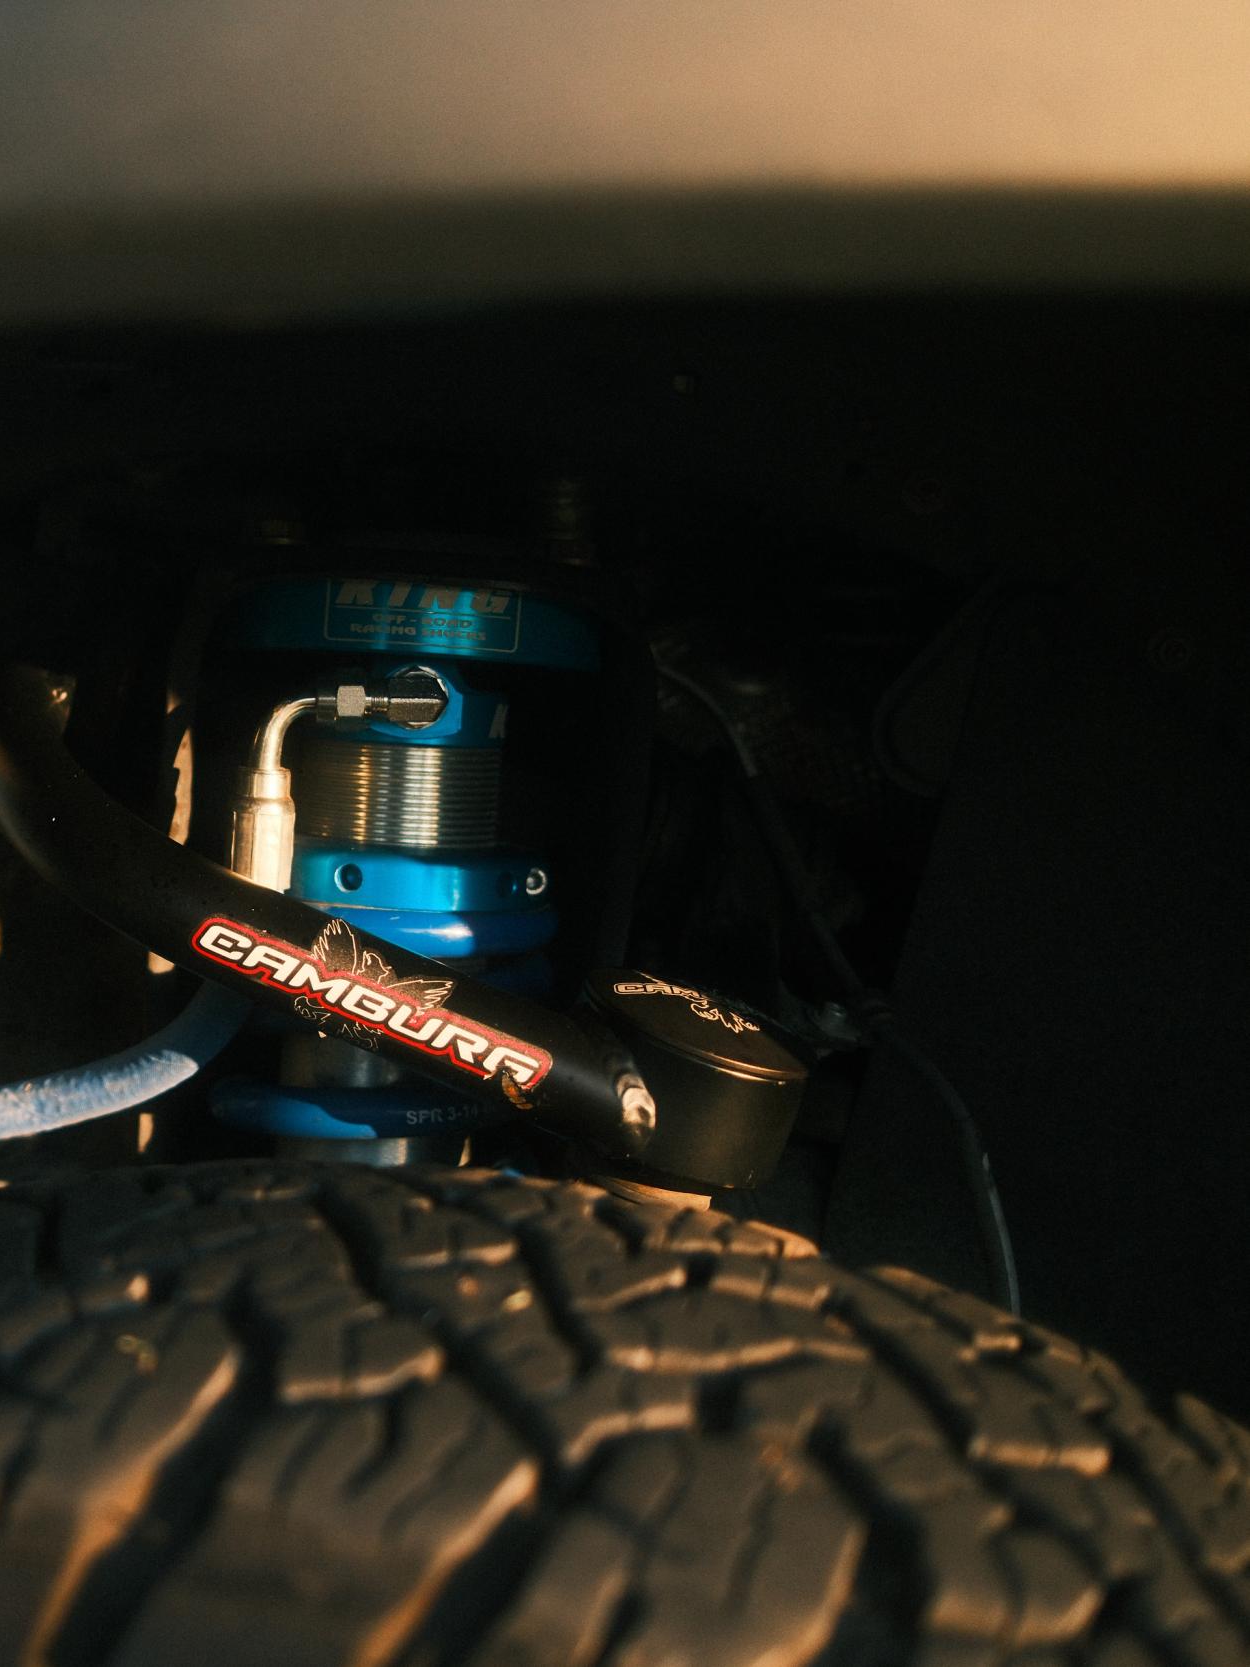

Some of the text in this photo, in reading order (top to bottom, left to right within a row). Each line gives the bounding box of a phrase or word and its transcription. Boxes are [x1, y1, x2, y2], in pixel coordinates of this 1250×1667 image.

[335, 580, 510, 614] KING
[350, 623, 417, 637] RACING
[199, 923, 540, 1083] CAMBURG
